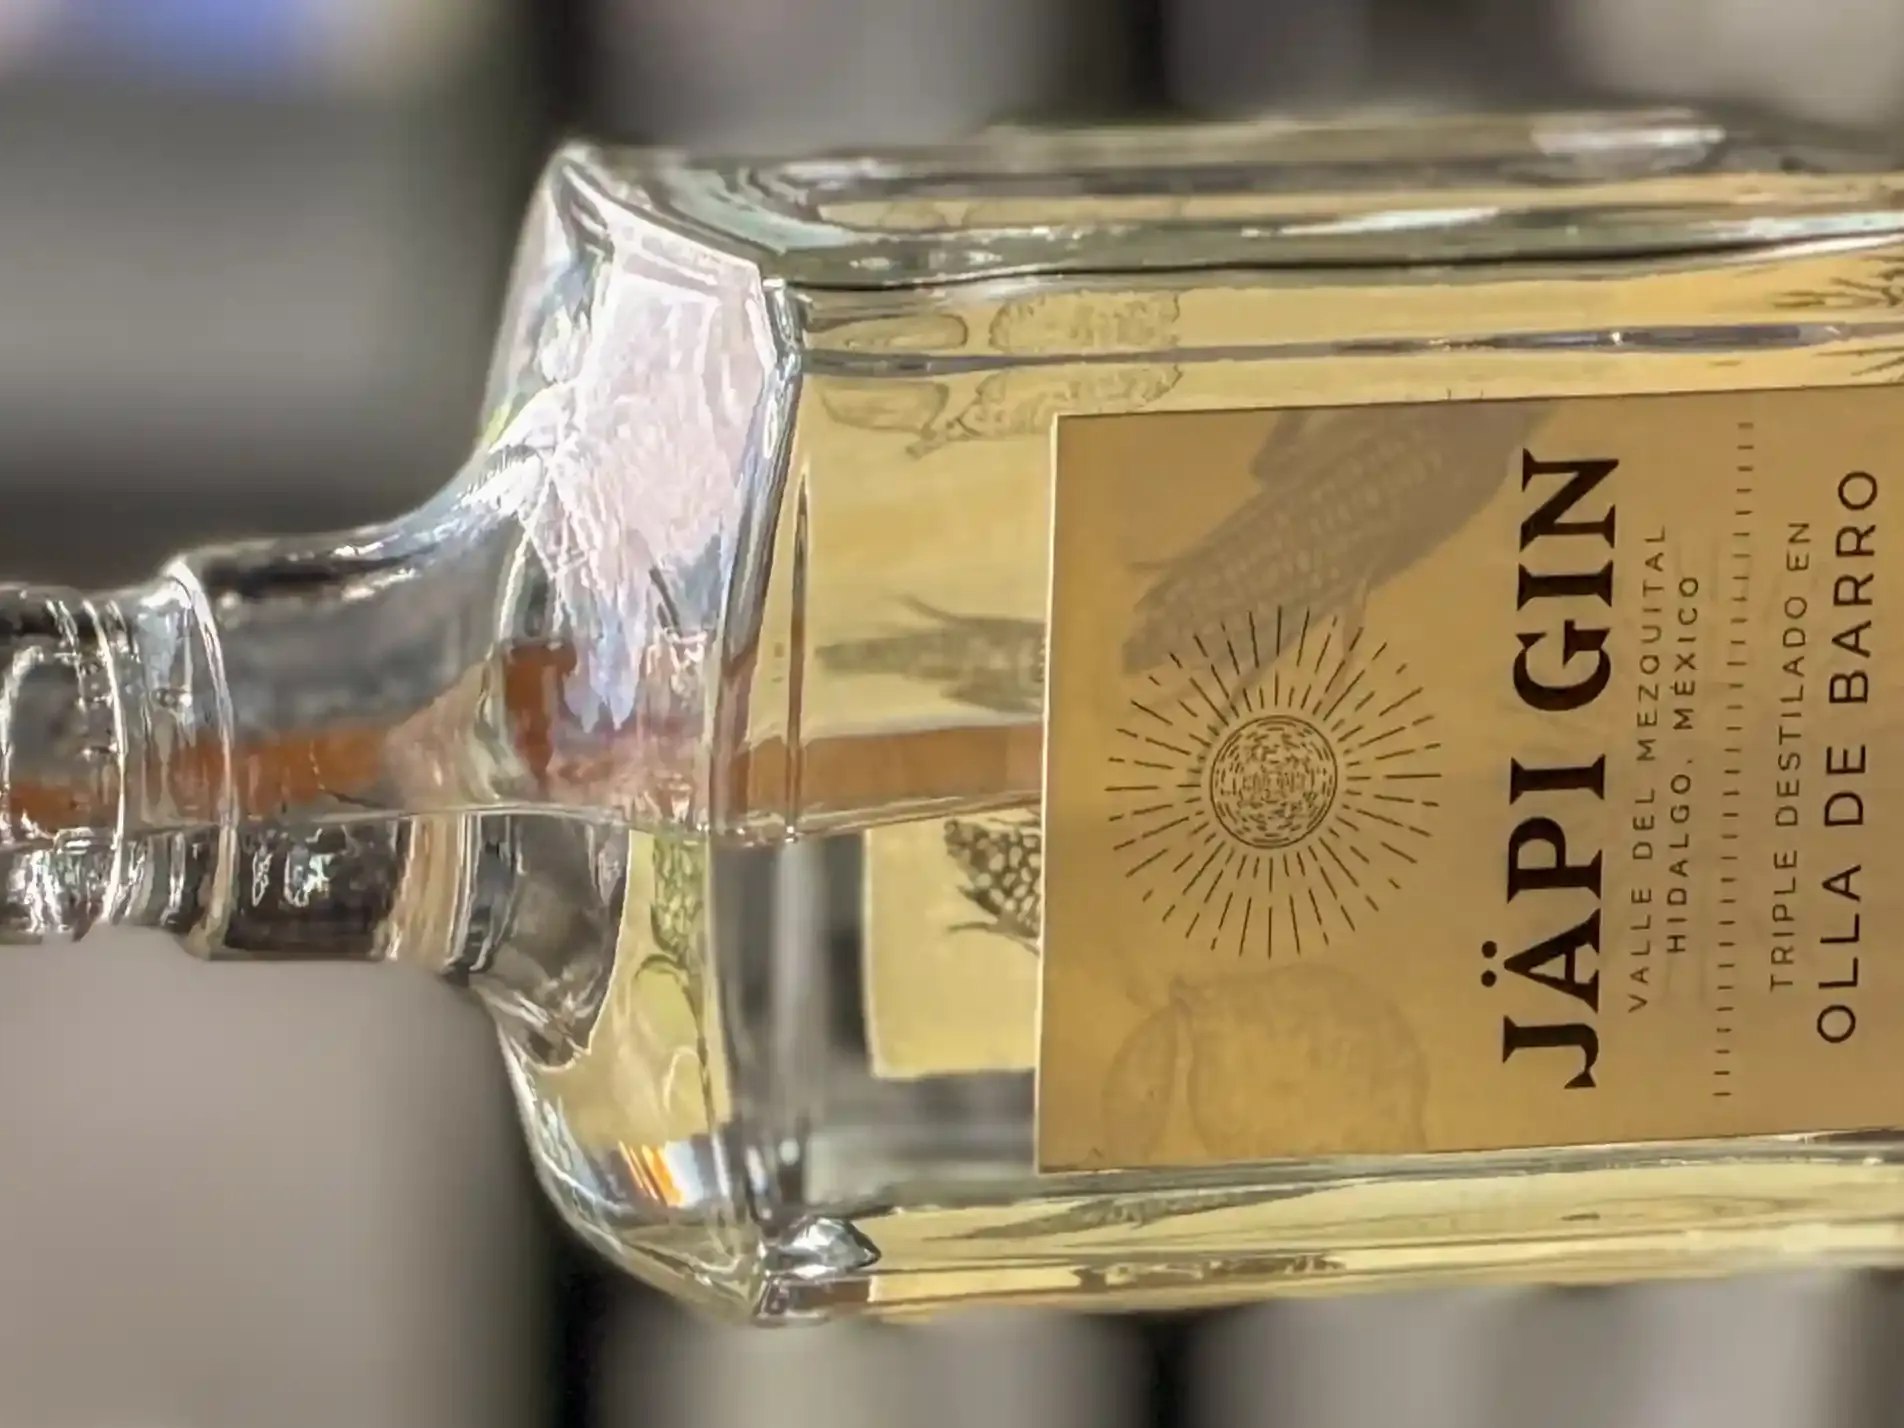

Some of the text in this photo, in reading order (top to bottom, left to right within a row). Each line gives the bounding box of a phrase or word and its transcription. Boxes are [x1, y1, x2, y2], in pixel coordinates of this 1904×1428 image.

[1480, 447, 1620, 1090] JÄPI GIN
[1627, 526, 1666, 1014] VALLE DEL MEZQUITAL
[1669, 576, 1699, 731] MÉXICO
[1769, 522, 1812, 993] TRIPLE DESTILADO EN
[1815, 470, 1879, 1045] OLLA DE BARRO
